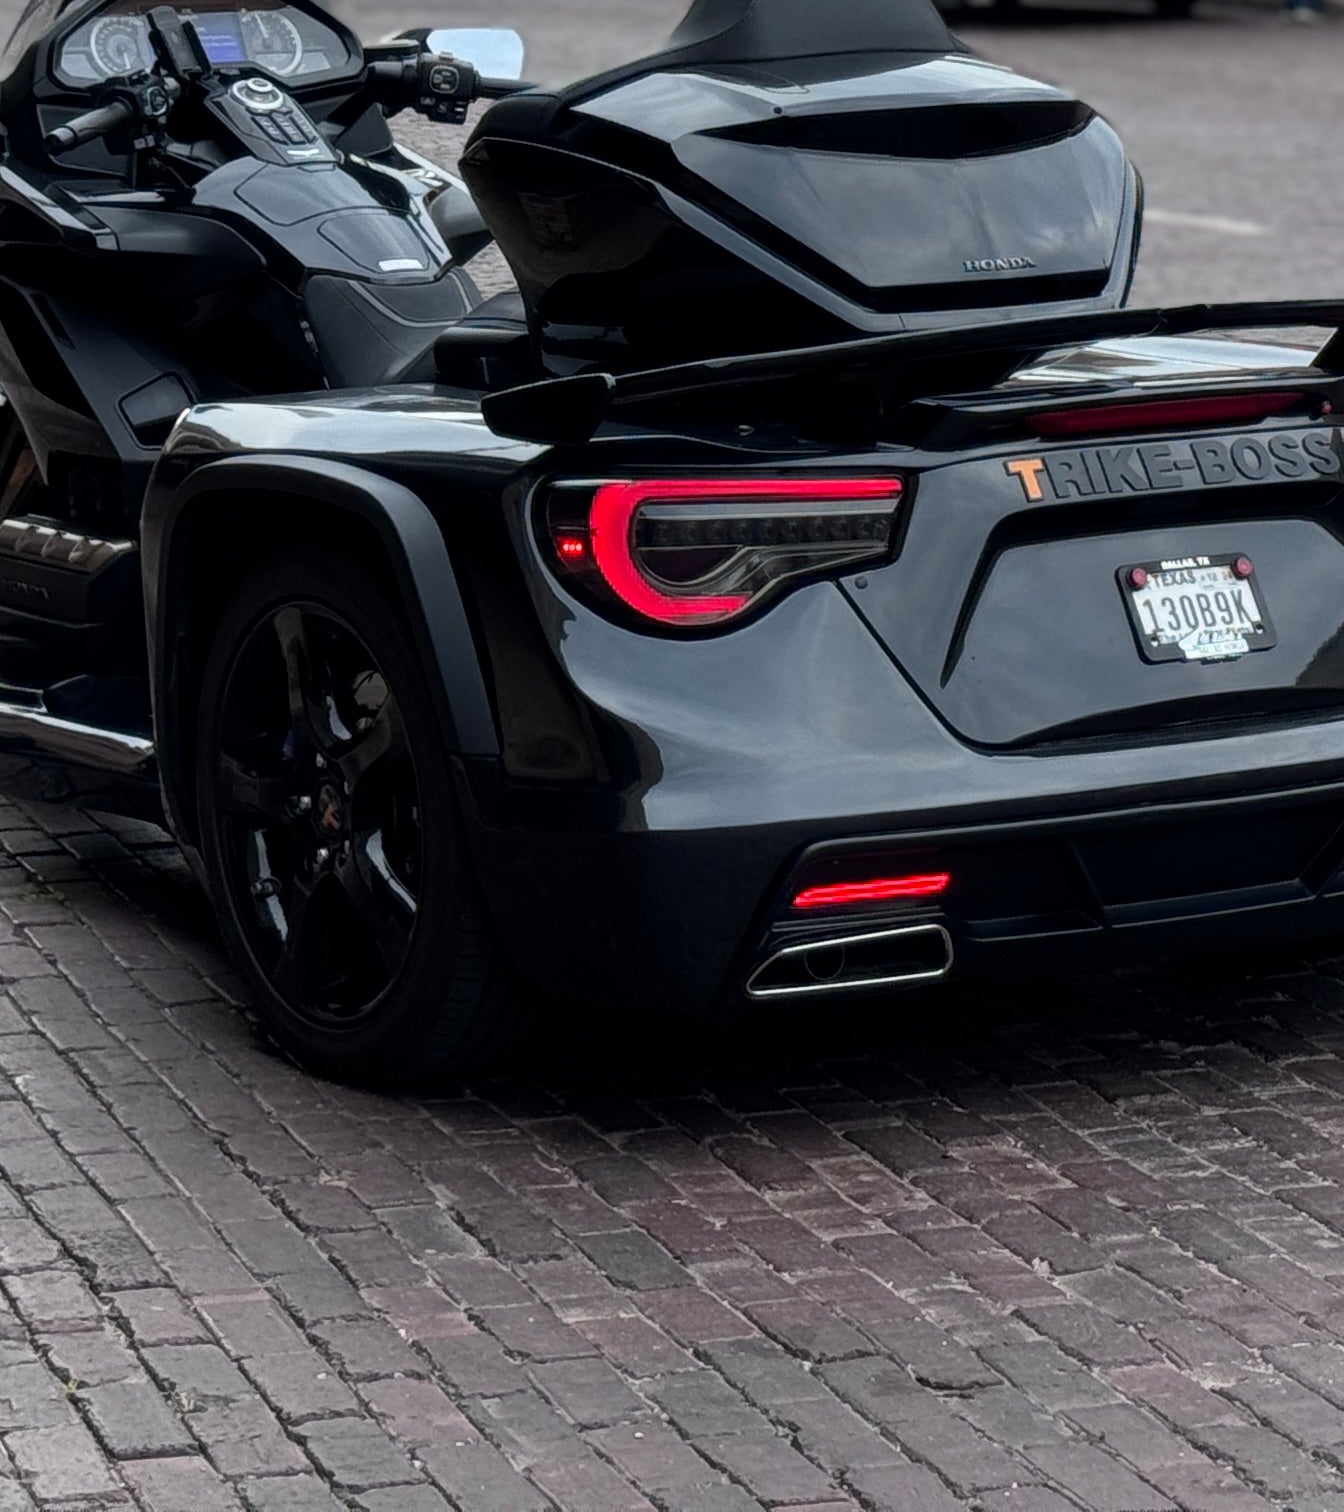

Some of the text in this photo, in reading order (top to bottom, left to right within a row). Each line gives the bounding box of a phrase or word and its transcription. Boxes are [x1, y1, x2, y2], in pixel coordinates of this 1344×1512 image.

[963, 256, 1036, 273] HONDA
[1004, 432, 1342, 502] TRIKE-BOSS
[1152, 569, 1197, 587] TEXAS
[1143, 589, 1253, 632] 130B9K
